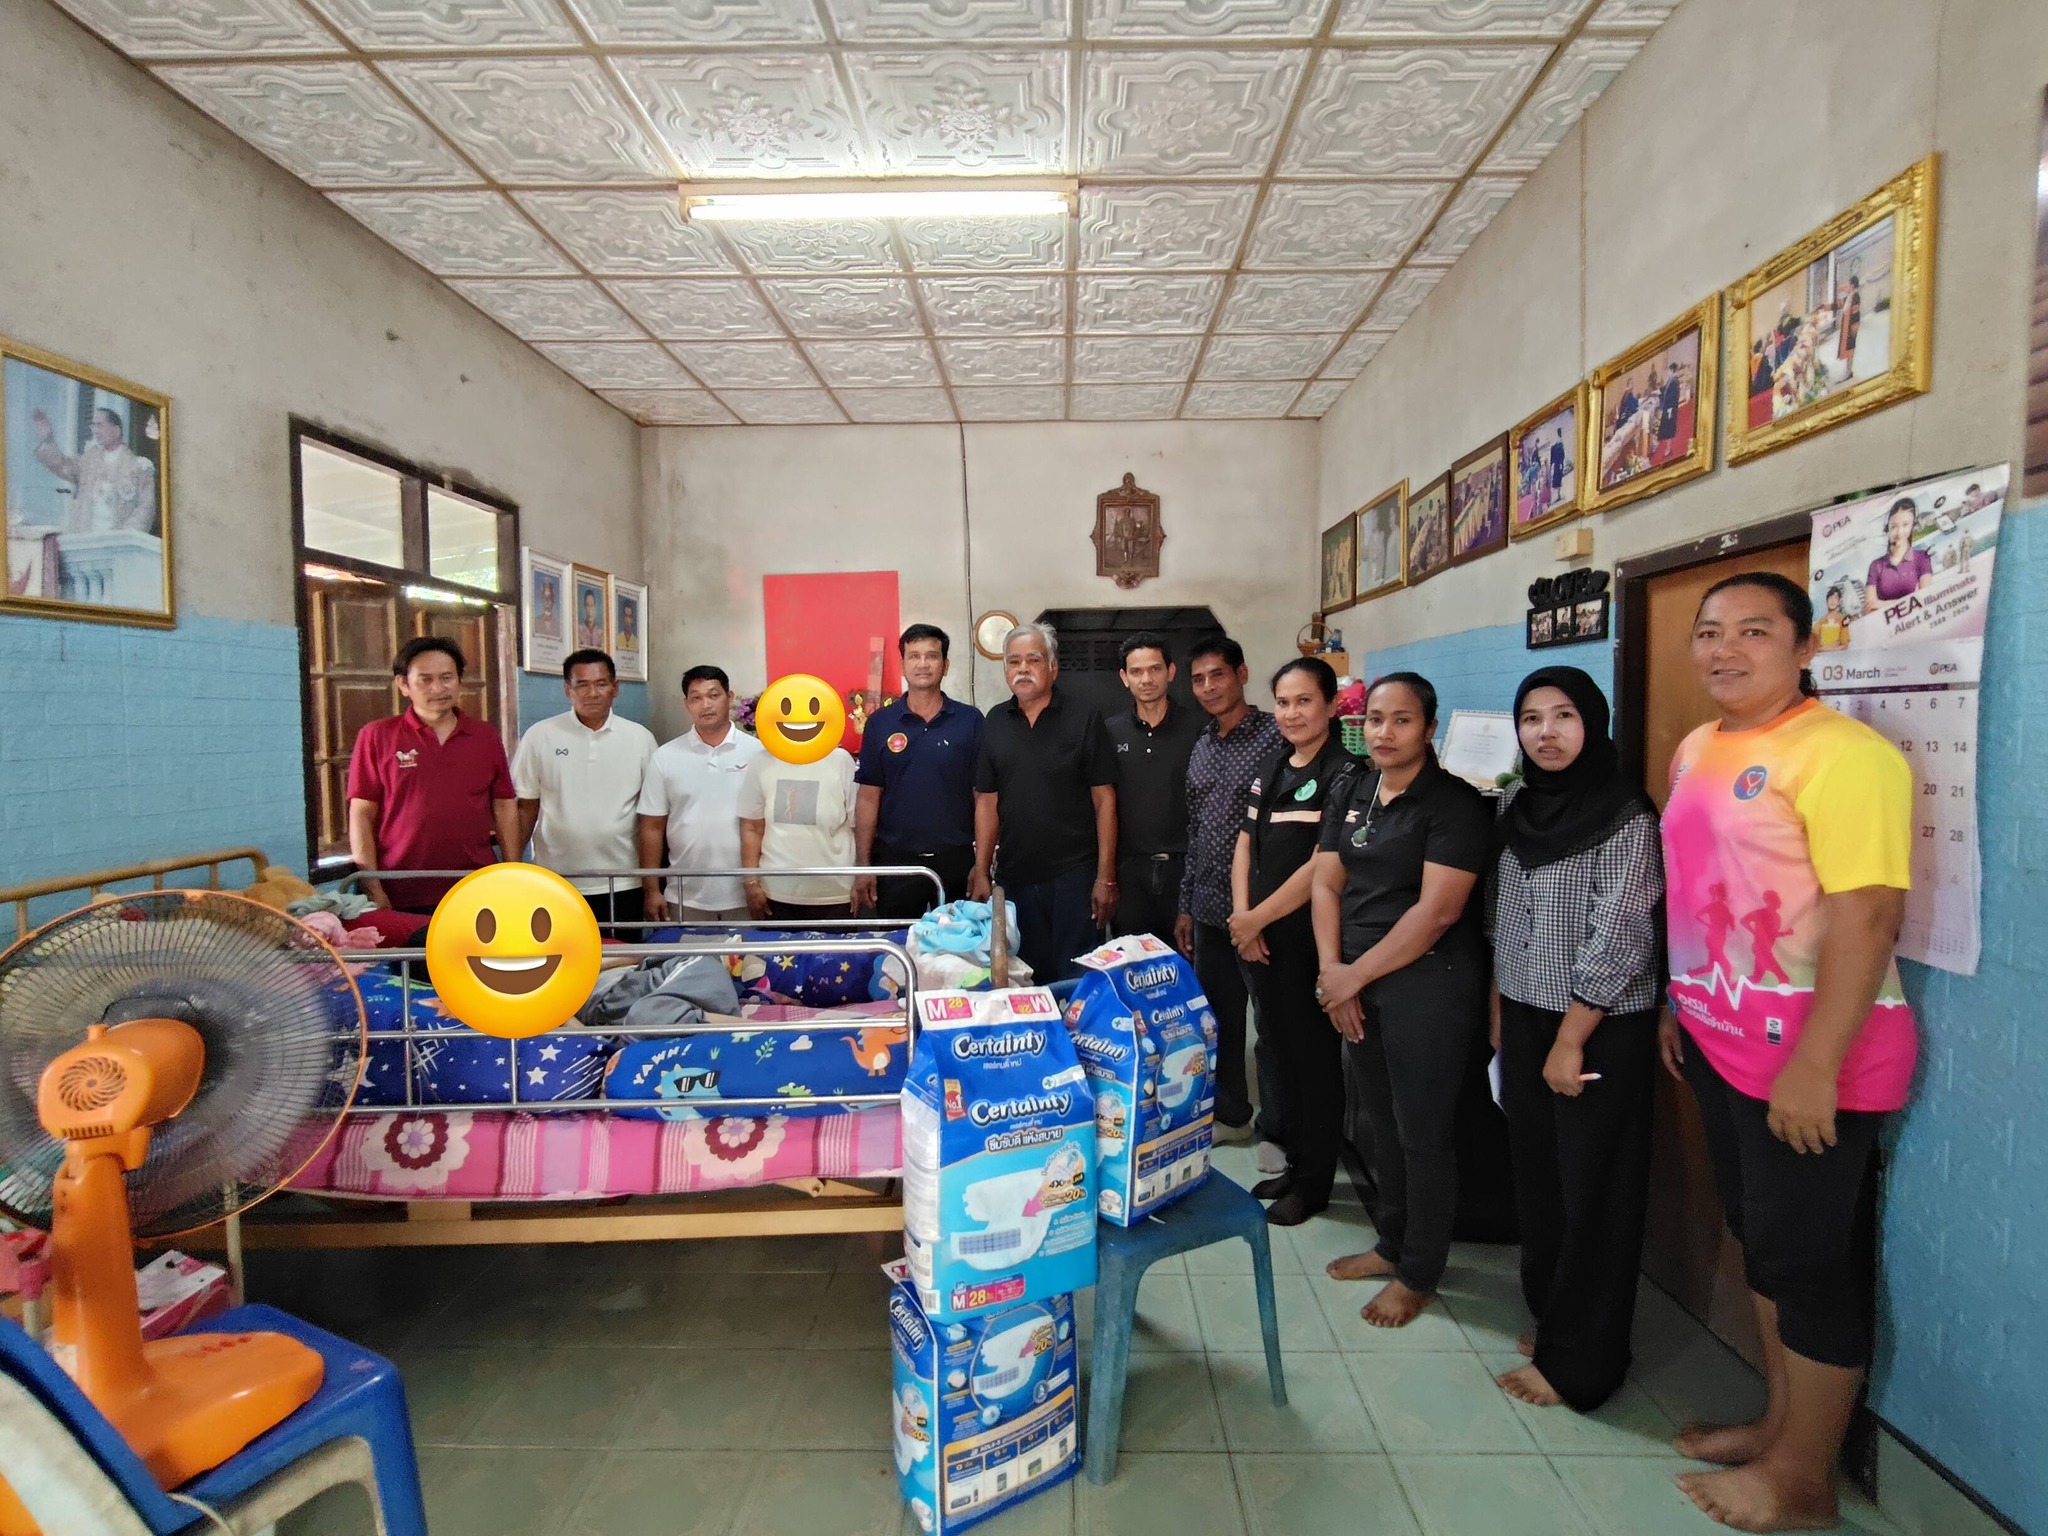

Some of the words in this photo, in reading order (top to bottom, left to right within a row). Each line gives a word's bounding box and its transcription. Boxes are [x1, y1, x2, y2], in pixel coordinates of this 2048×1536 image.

[1832, 516, 1851, 531] PEA
[1884, 596, 1922, 625] PEA
[1924, 575, 1976, 605] Illuminate
[1894, 616, 1921, 634] Alert
[1923, 610, 1932, 621] &
[1935, 588, 1979, 614] Answer
[1823, 665, 1843, 681] 03
[1846, 667, 1880, 680] March
[1939, 663, 1957, 673] PEA
[1857, 700, 1863, 710] 3
[1880, 700, 1886, 709] 4
[1904, 699, 1911, 709] 5
[1930, 698, 1937, 709] 6
[1958, 697, 1965, 708] 7
[1900, 740, 1912, 751] 12
[1925, 741, 1939, 752] 13
[1953, 742, 1967, 753] 14
[1923, 783, 1937, 795] 20
[1951, 785, 1964, 797] 21
[1922, 826, 1936, 838] 27
[1949, 829, 1963, 842] 28
[926, 999, 948, 1020] M
[948, 998, 963, 1008] 28
[954, 1031, 1046, 1058] Certainty
[633, 1044, 692, 1085] YAWN!
[946, 1094, 963, 1110] No.1
[971, 1093, 1071, 1124] Certainty
[953, 1294, 965, 1310] M
[969, 1290, 986, 1307] 28
